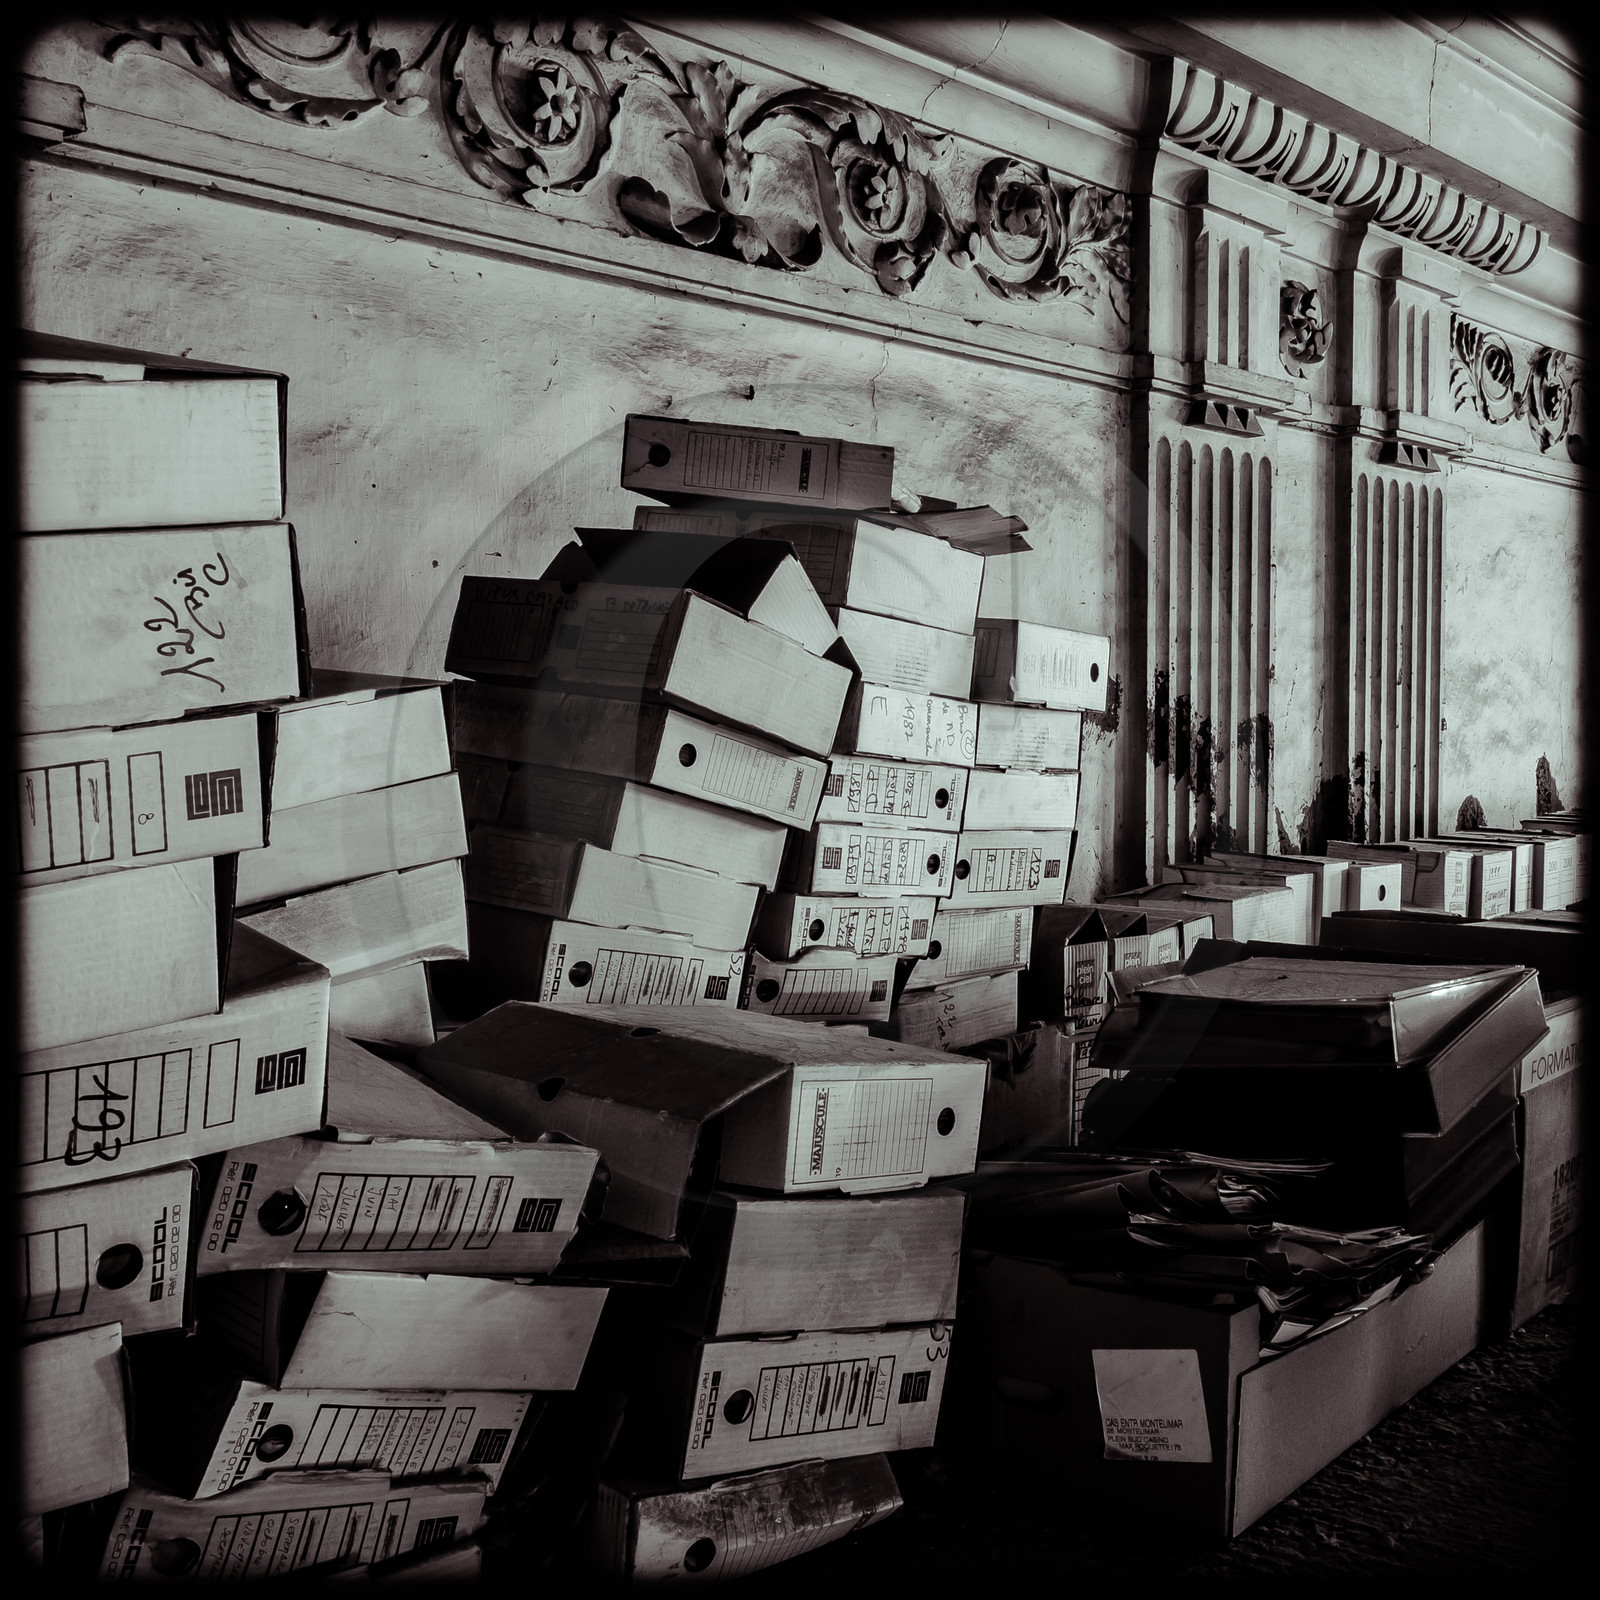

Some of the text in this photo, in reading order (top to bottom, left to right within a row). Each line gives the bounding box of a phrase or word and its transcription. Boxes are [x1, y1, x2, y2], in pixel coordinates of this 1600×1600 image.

[787, 770, 804, 811] MAJUSCULE
[1028, 851, 1042, 889] 123
[802, 908, 811, 948] SCOO
[549, 944, 567, 1002] SCOOL
[730, 953, 744, 979] 52
[1077, 964, 1094, 977] plein
[1079, 973, 1092, 984] ciel
[811, 1091, 829, 1171] MAJUSCULE
[206, 1161, 240, 1251] Réf. 020 02 00
[221, 1162, 258, 1254] SCOOL
[149, 1206, 168, 1303] SCOOL
[167, 1204, 182, 1297] Réf. 020 02 00
[243, 1401, 260, 1425] Réf.
[698, 1392, 707, 1416] 020
[701, 1370, 722, 1450] SCOOL
[1105, 1418, 1118, 1428] CAS
[1140, 1419, 1183, 1428] MONTELIMAR
[231, 1402, 274, 1489] SCOOL
[233, 1427, 250, 1453] 020
[217, 1470, 234, 1491] 00
